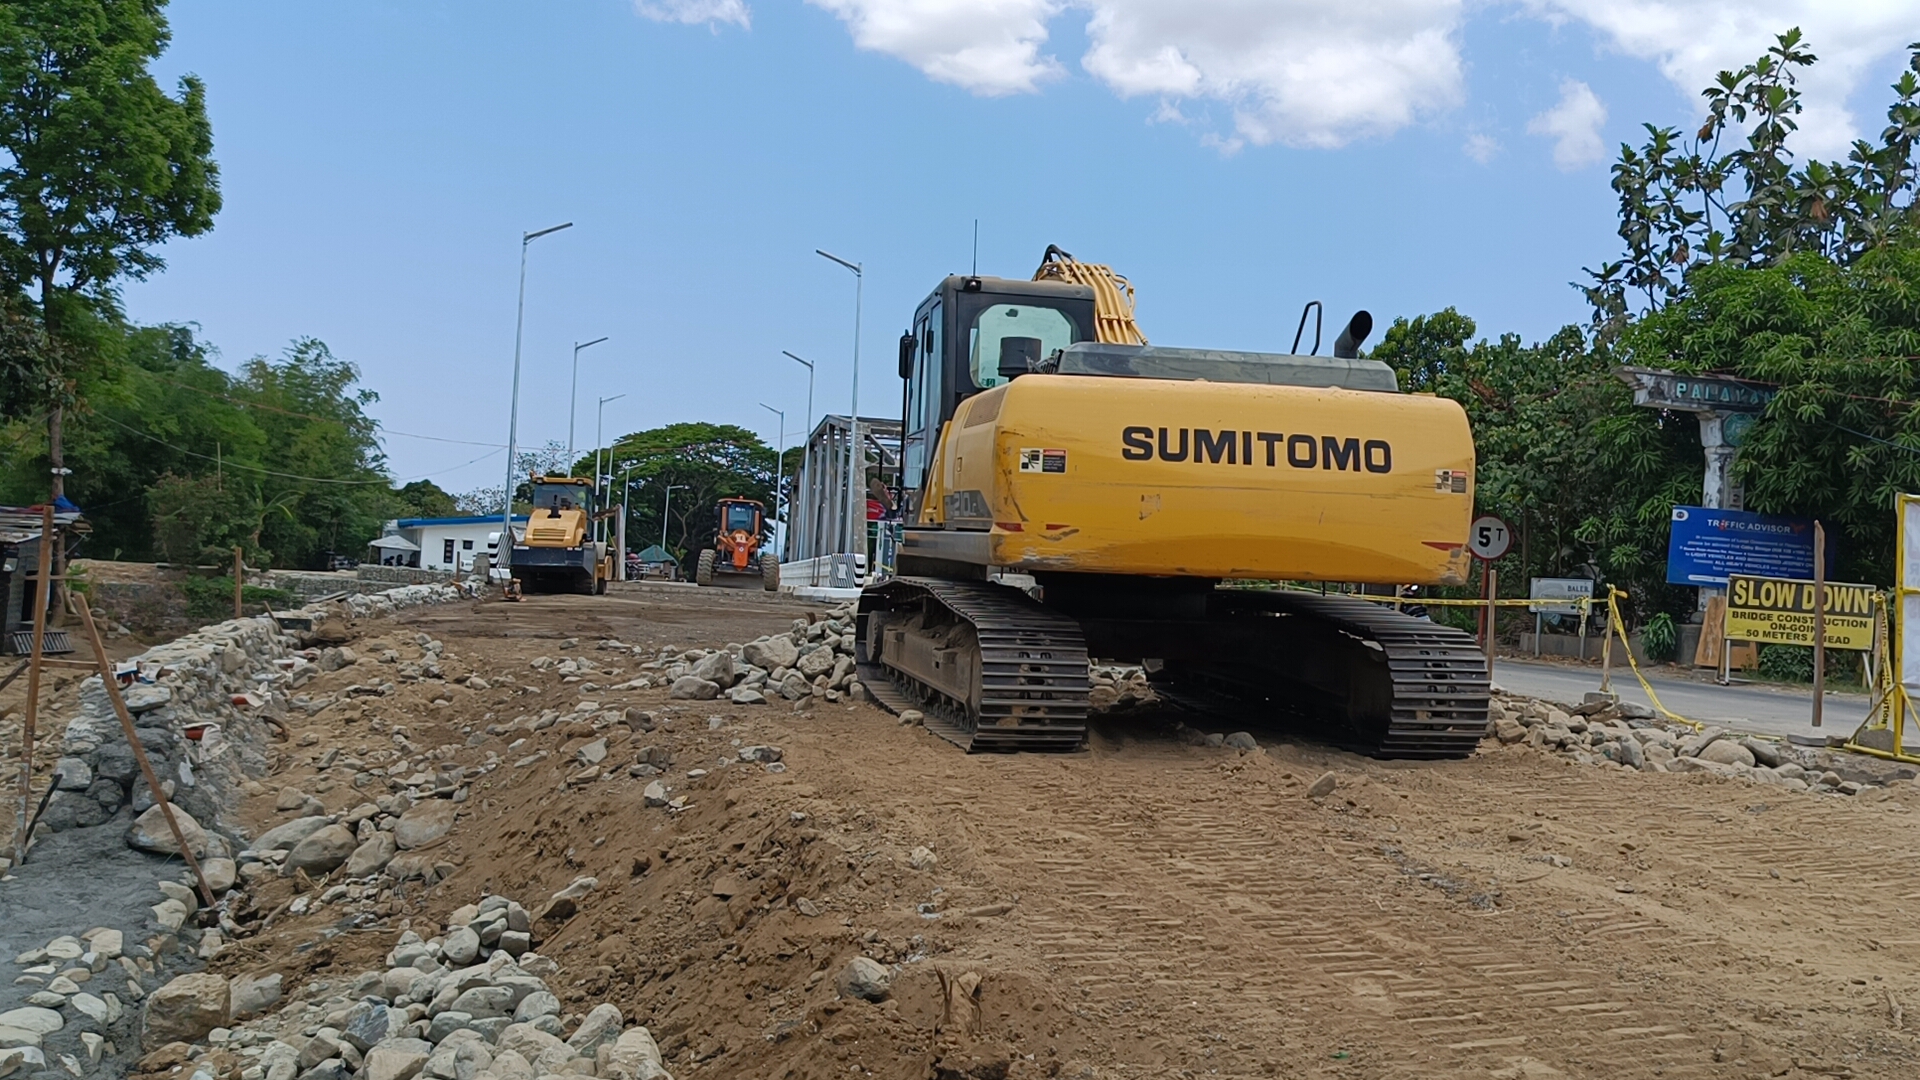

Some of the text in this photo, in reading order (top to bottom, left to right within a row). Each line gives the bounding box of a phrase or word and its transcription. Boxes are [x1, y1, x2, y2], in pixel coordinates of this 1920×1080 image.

[1121, 425, 1392, 474] SUMITOMO
[1733, 579, 1869, 614] SLOW DOWN
[1732, 611, 1868, 628] BRIDGE CONSTUCTION
[1746, 629, 1759, 637] 50
[1762, 631, 1808, 642] METERS
